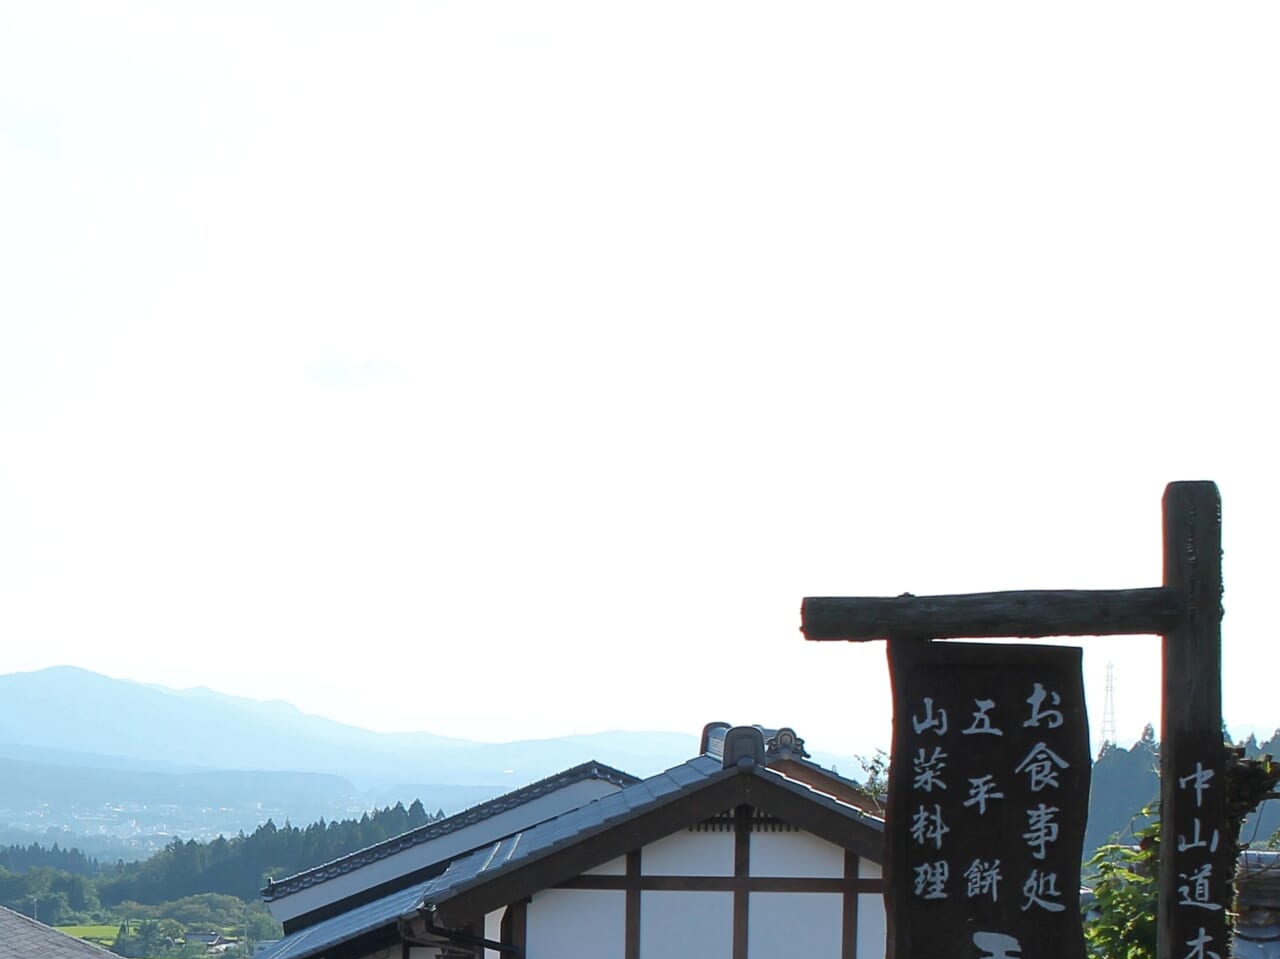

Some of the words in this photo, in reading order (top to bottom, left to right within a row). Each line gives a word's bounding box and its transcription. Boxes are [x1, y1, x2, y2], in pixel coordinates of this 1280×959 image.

[909, 696, 950, 901] 山菜料理
[960, 698, 1004, 903] 五平餅
[1014, 682, 1070, 913] お食事処
